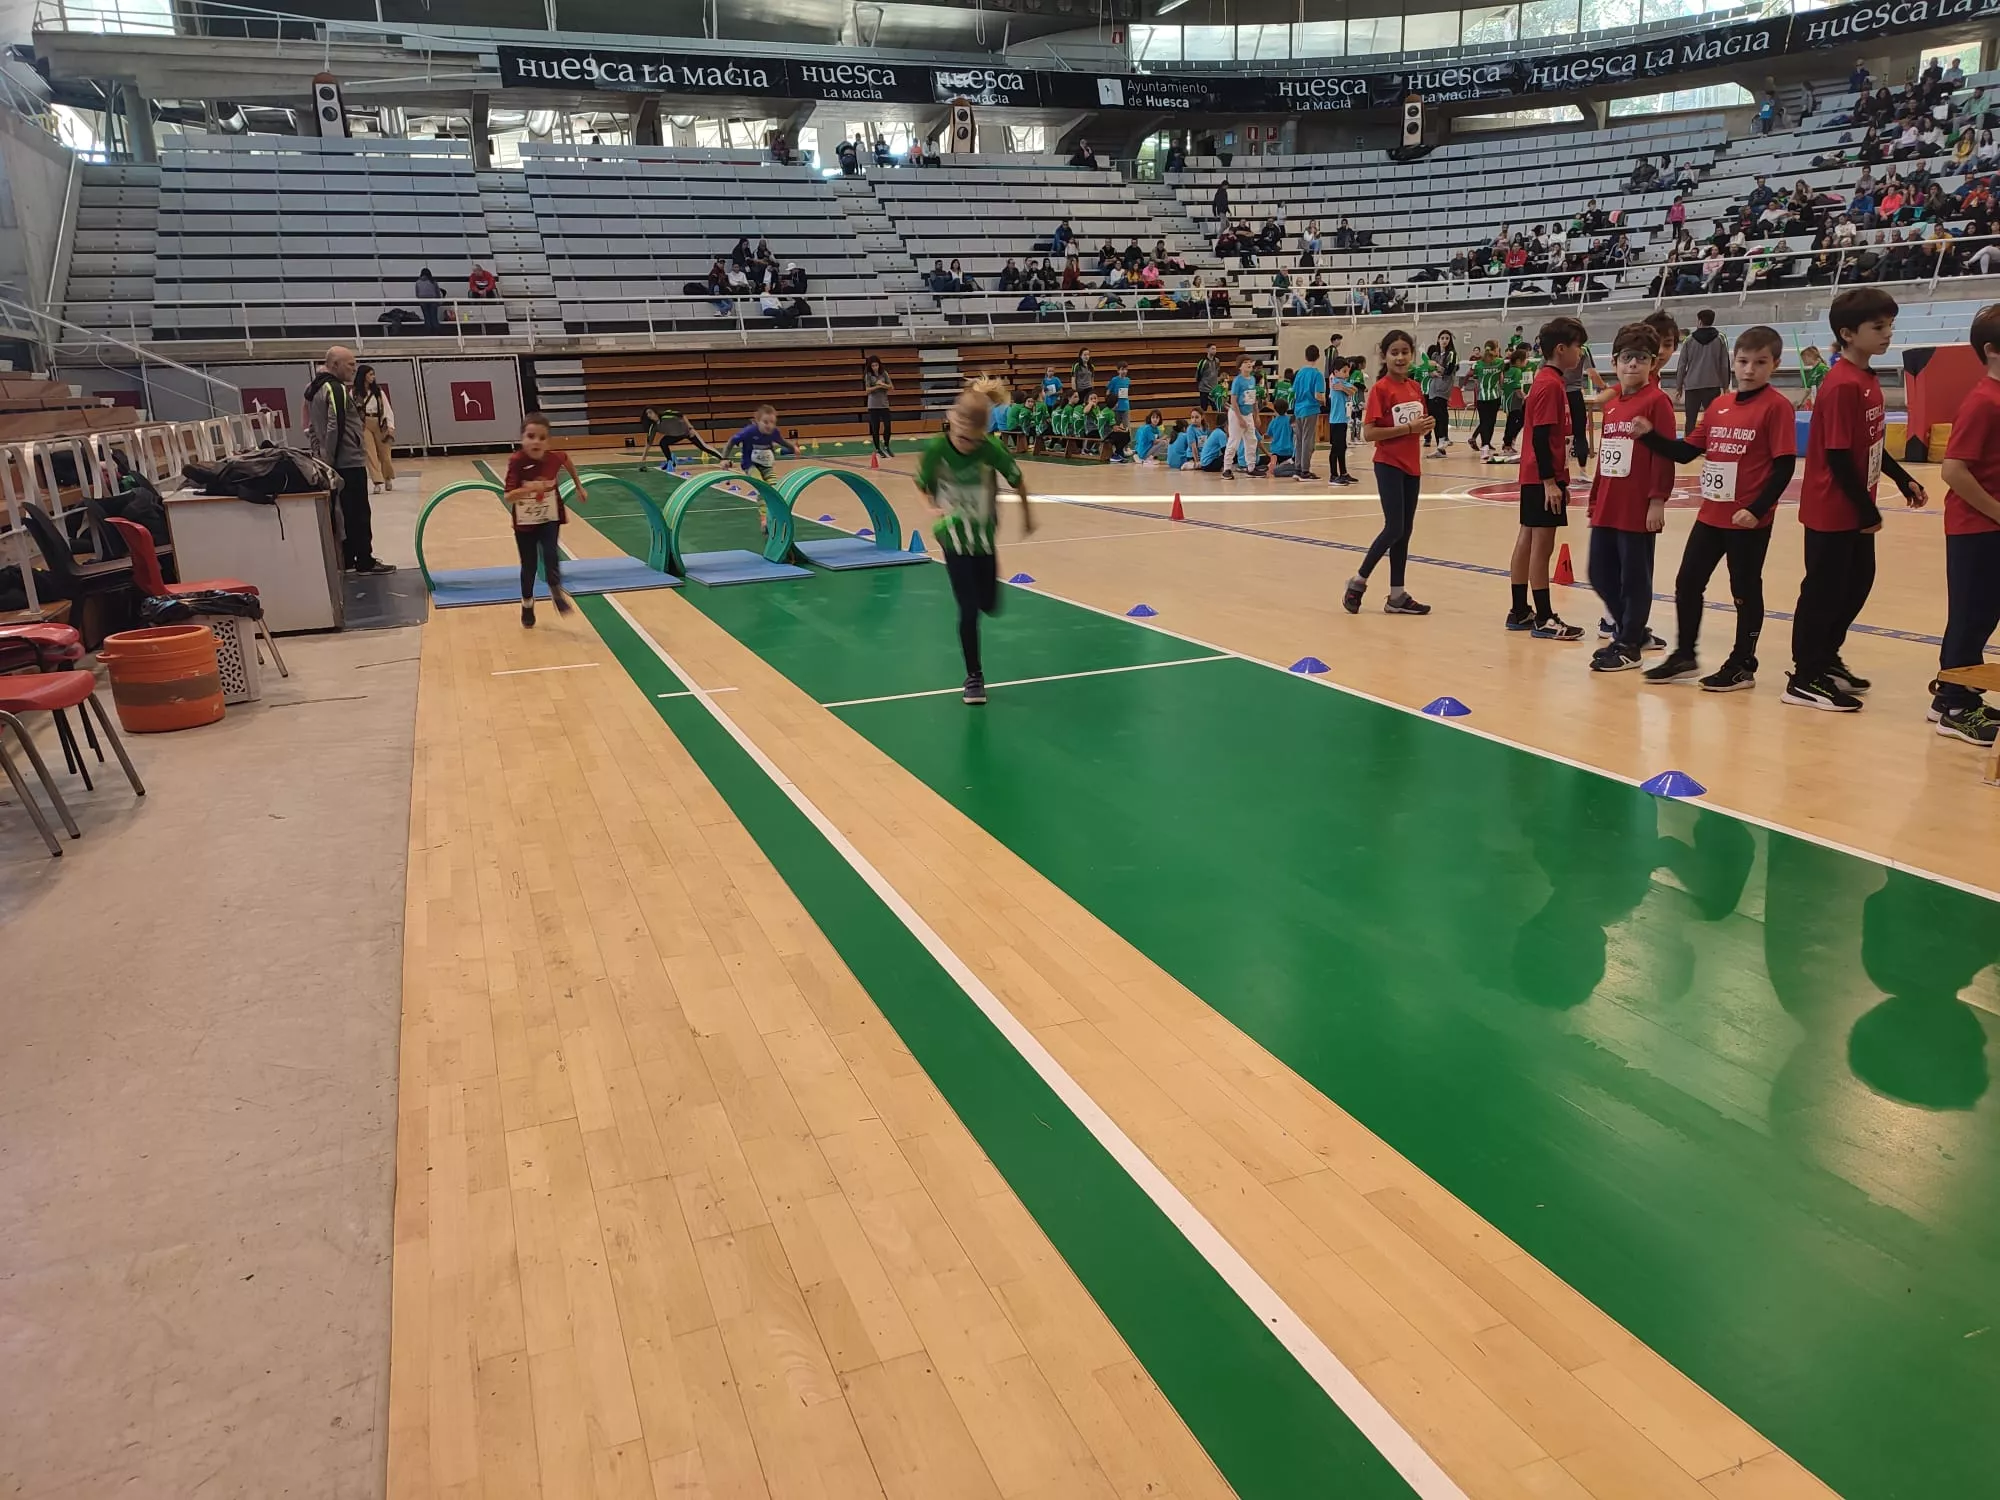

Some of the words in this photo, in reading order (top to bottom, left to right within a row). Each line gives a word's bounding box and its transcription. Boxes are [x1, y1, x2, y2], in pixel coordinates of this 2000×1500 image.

[1806, 1, 1928, 42] Huesca
[516, 57, 636, 83] Huesca
[642, 63, 676, 84] La
[800, 64, 897, 86] Huesca
[1531, 53, 1637, 84] Huesca
[1645, 47, 1674, 69] La
[1127, 79, 1208, 94] Ayuntamiento
[1279, 77, 1367, 96] Huesca
[1407, 66, 1501, 90] Huesca
[1129, 97, 1142, 107] de
[1145, 96, 1190, 108] Huesca
[1463, 332, 1472, 344] 2
[1733, 428, 1756, 441] RUBIO
[1719, 443, 1747, 455] HUESCA
